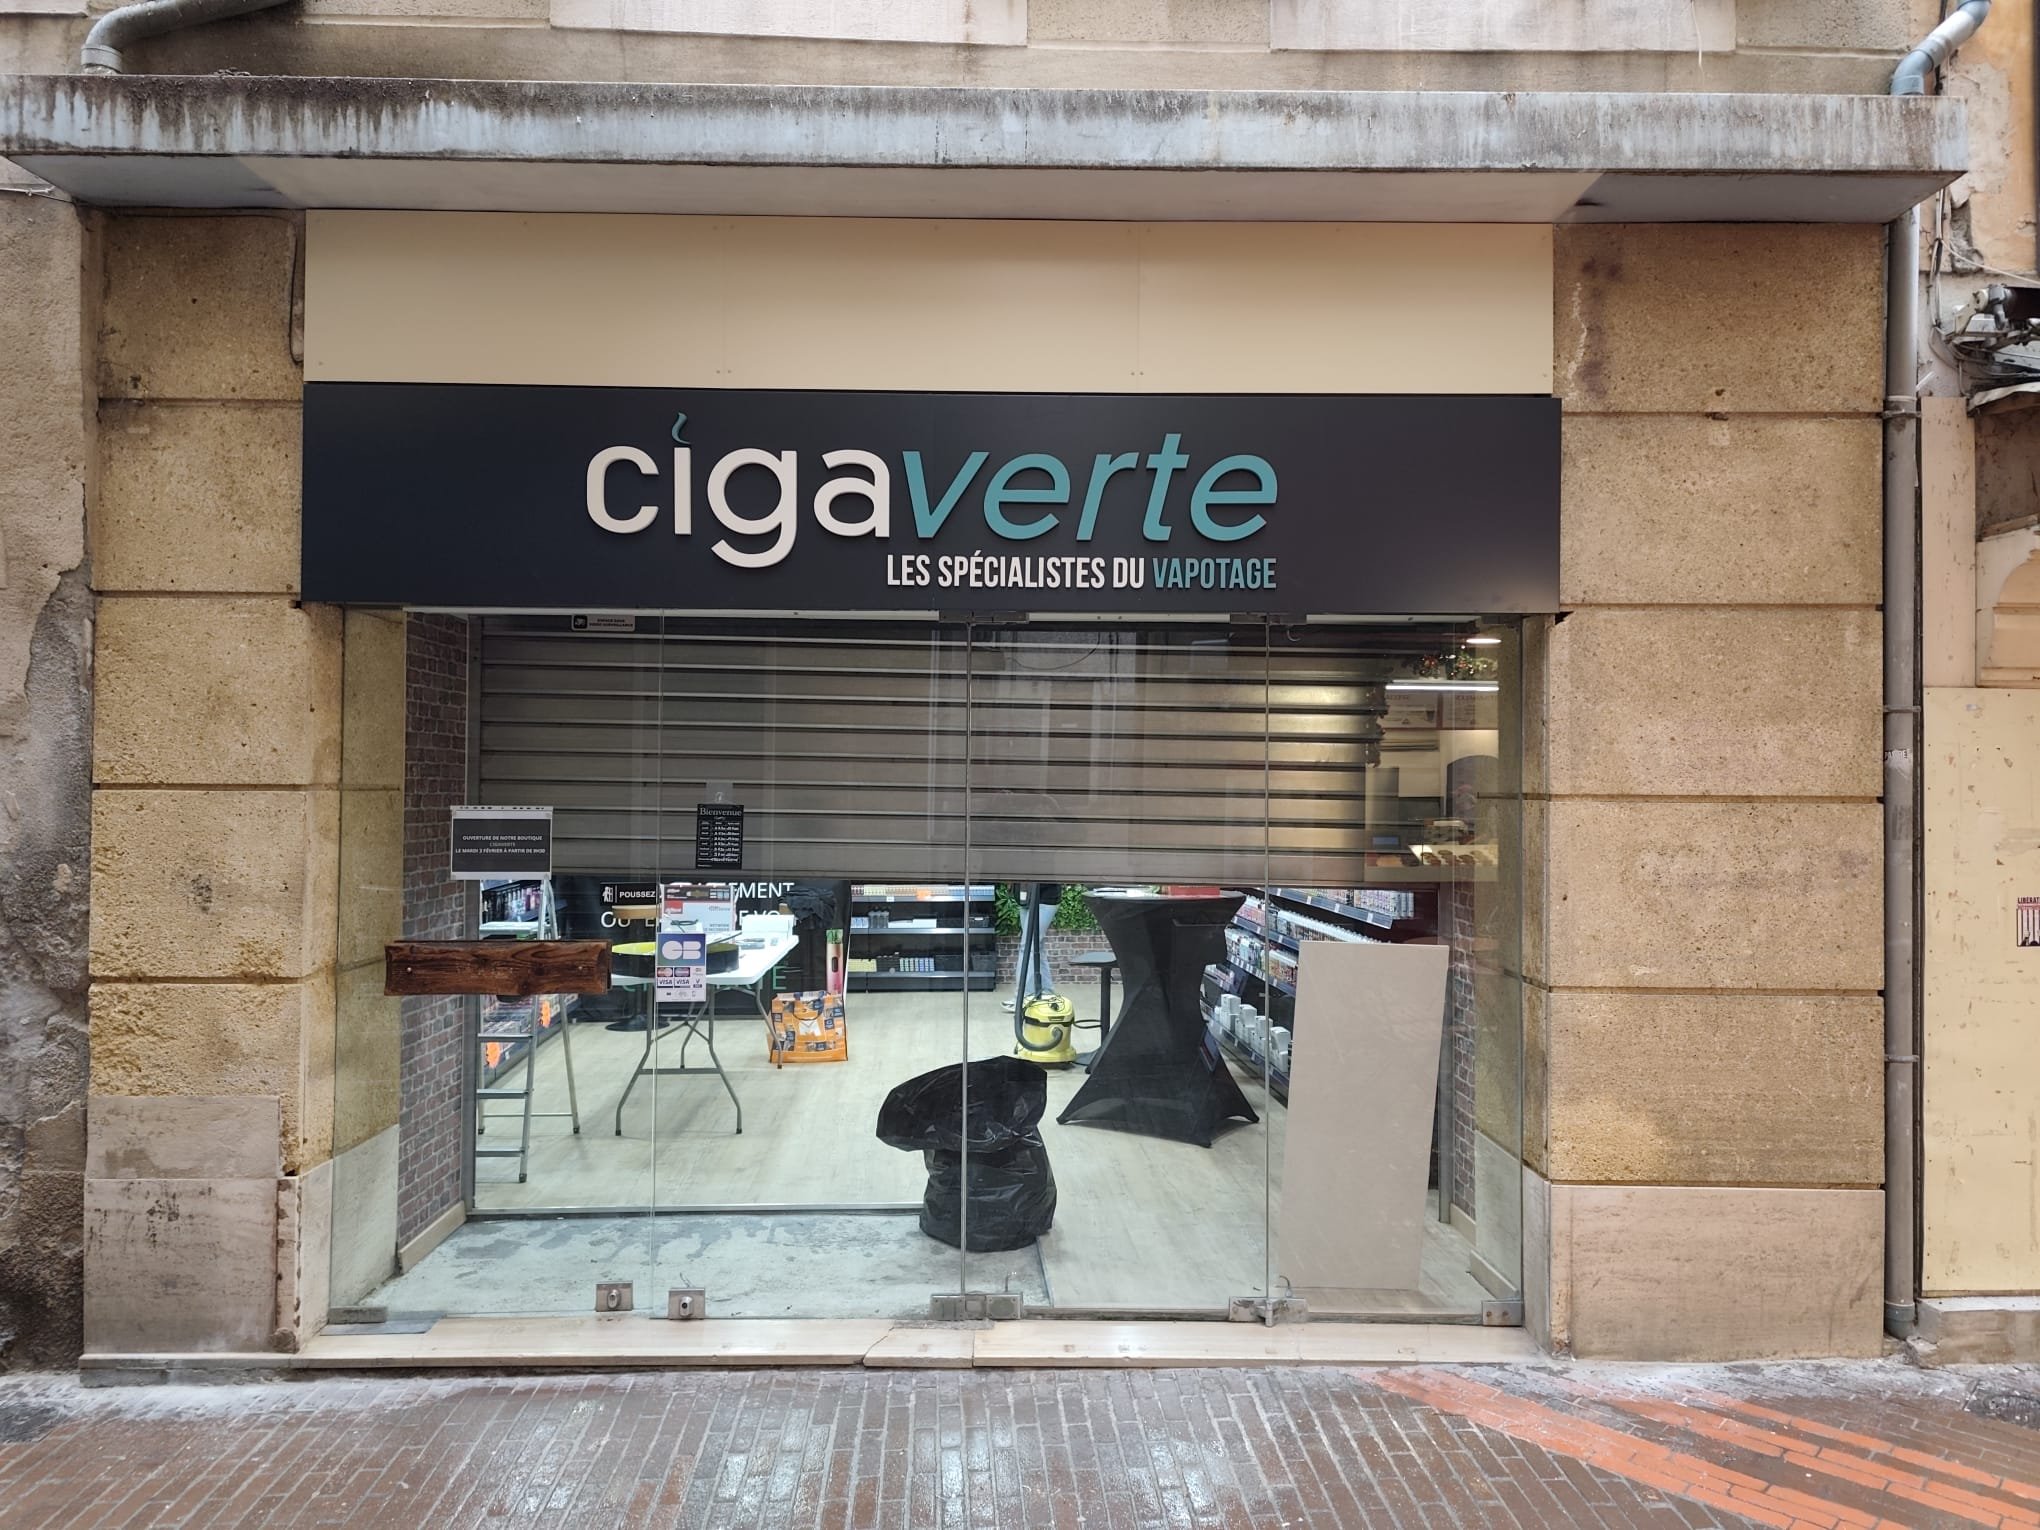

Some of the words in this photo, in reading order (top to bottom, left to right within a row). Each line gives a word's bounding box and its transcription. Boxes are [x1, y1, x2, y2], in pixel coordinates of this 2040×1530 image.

[586, 412, 1278, 568] cigaverte
[887, 554, 931, 586] LES
[938, 550, 1106, 589] SPÉCIALISTES
[1112, 557, 1145, 589] DU
[1152, 557, 1277, 589] VAPOTAGE
[700, 807, 742, 817] Bienvenue
[619, 890, 656, 898] POUSSEZ
